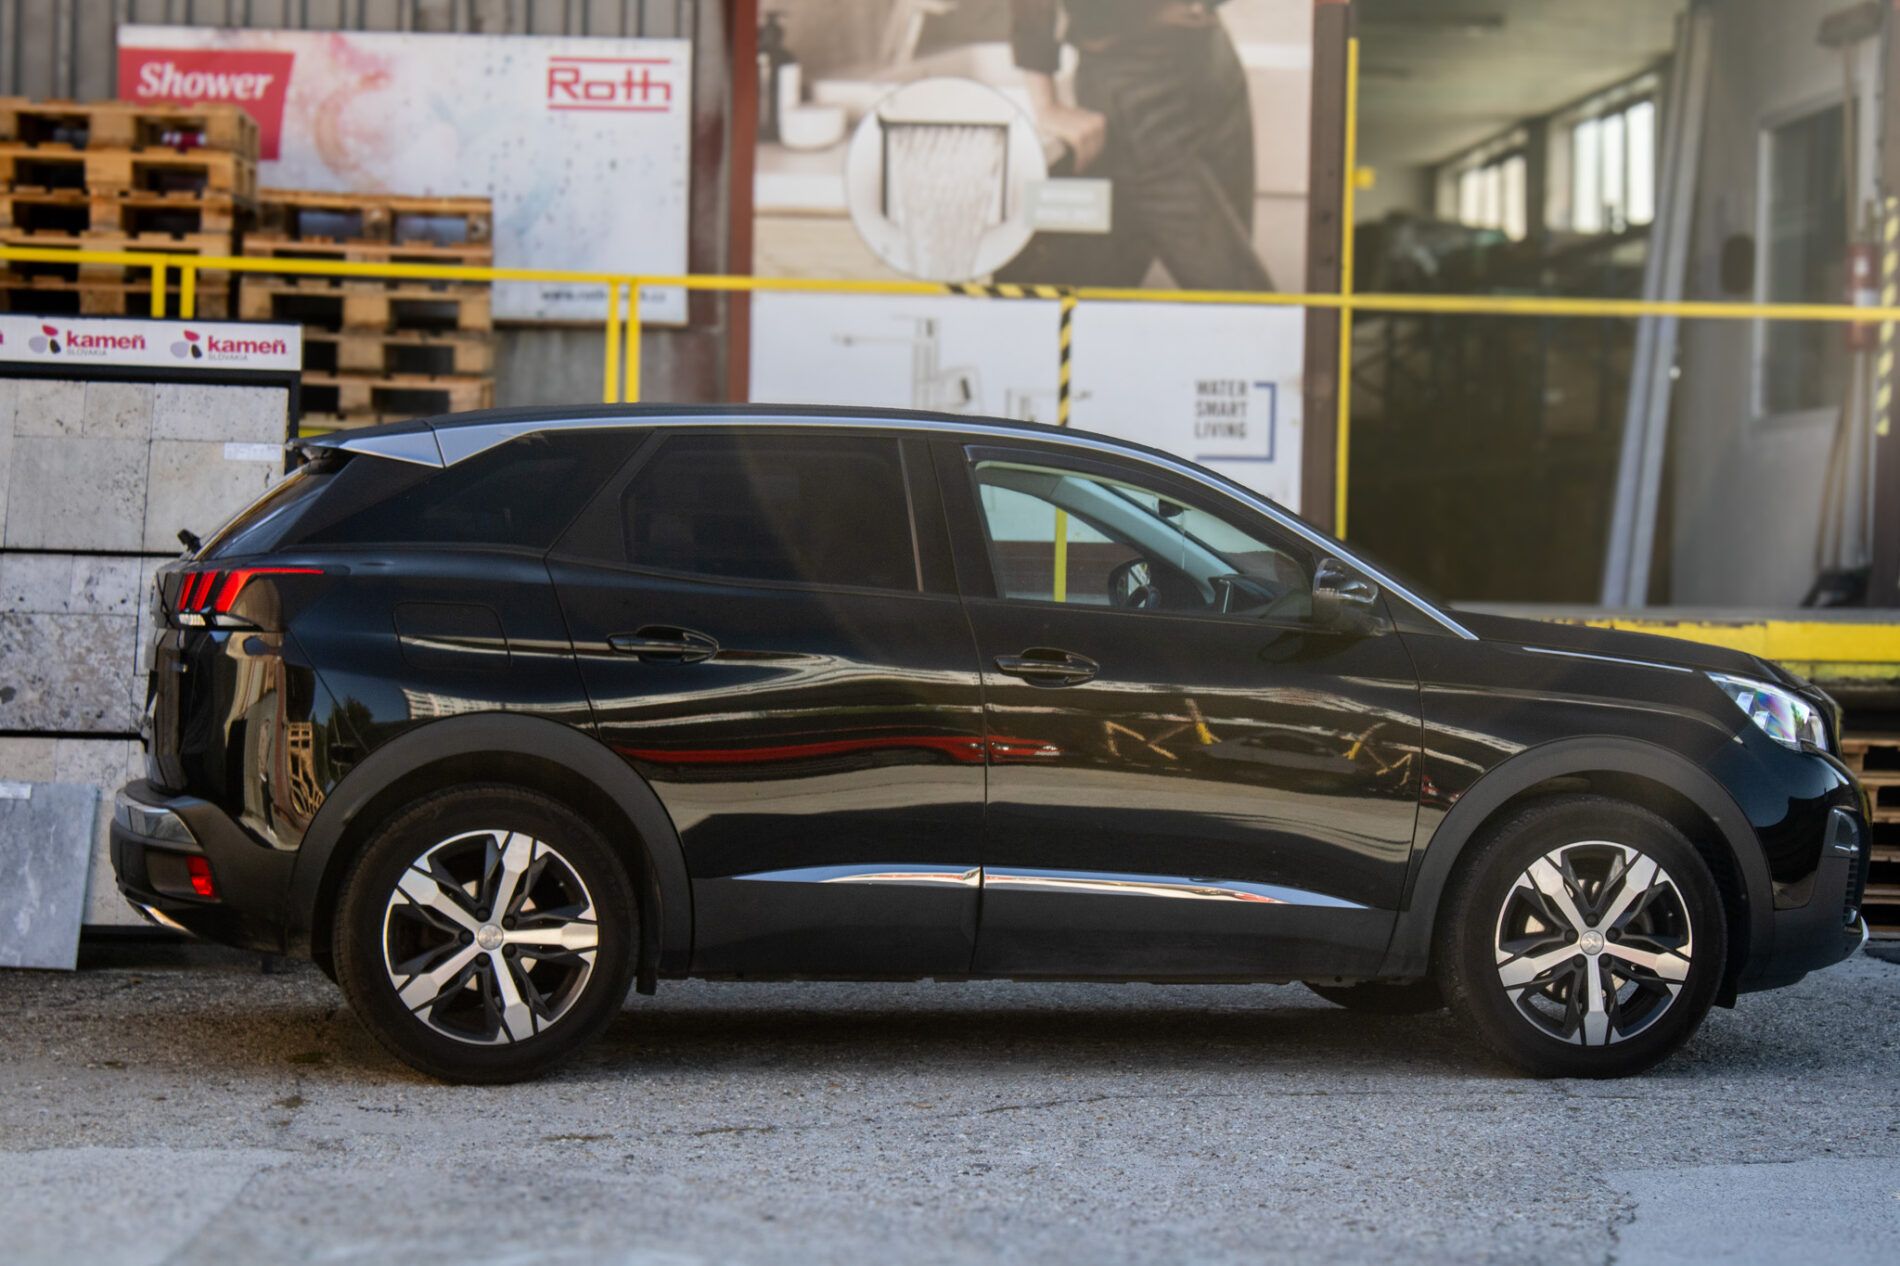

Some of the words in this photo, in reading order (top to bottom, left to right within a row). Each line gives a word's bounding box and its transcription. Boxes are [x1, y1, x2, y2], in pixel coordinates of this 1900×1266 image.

[137, 61, 273, 100] Shower
[547, 66, 672, 101] Roth
[66, 348, 108, 356] SLOVAKIA
[208, 353, 248, 361] SLOVAKIA
[1195, 380, 1247, 396] WATER
[1195, 401, 1247, 417] SMART
[1195, 422, 1247, 439] LIVING
